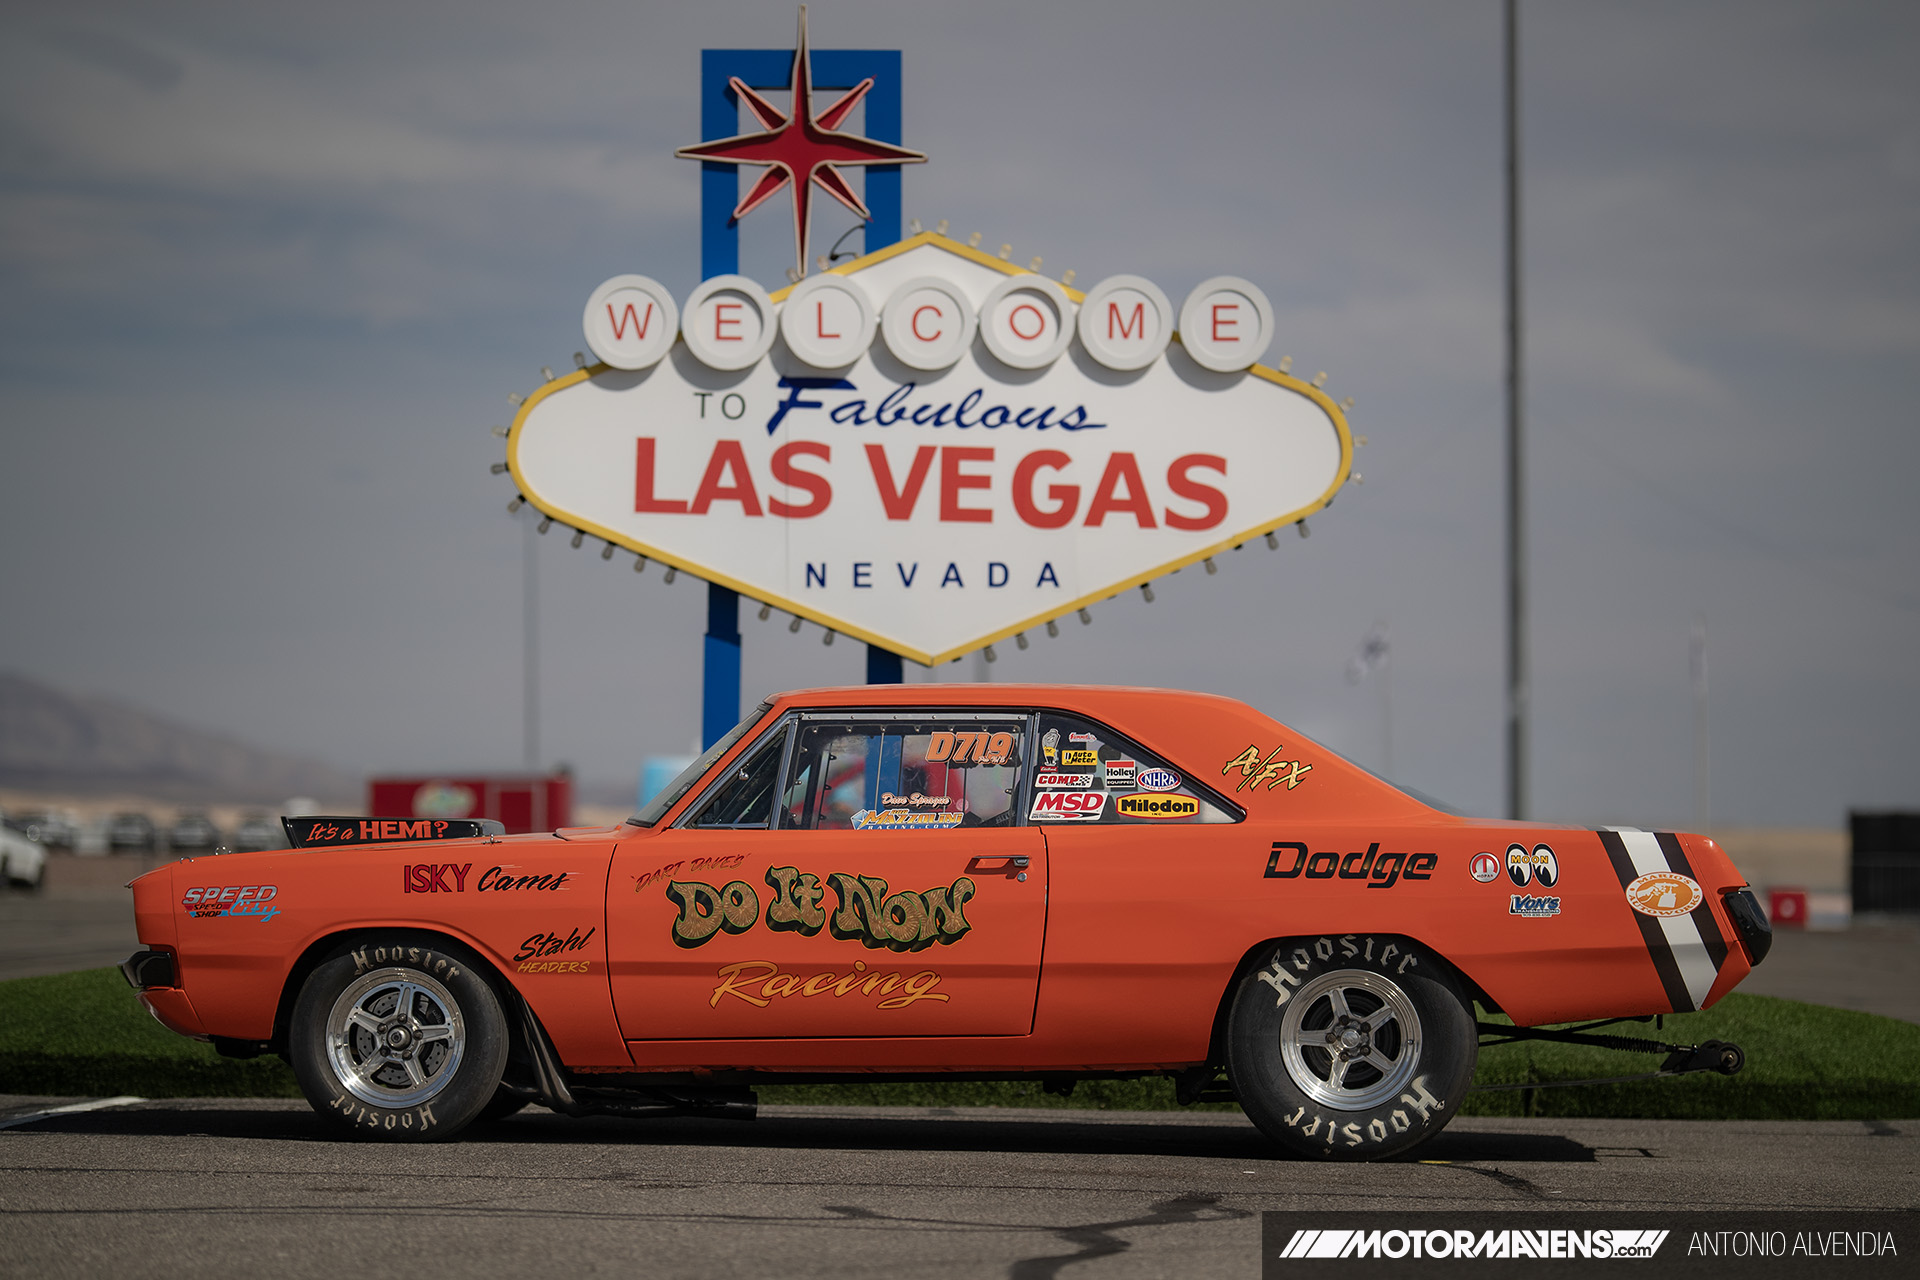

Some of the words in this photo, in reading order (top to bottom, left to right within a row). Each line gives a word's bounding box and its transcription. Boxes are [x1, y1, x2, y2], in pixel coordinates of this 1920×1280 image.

[606, 302, 1239, 343] WELCOME
[693, 392, 746, 420] TO
[766, 376, 1107, 435] Fabulous
[633, 437, 832, 518] LAS
[864, 444, 1229, 531] VEGAS
[805, 562, 1060, 589] NEVADA
[925, 732, 1015, 763] D719
[1038, 775, 1080, 784] COMP
[1106, 768, 1135, 778] Holley
[1144, 772, 1175, 786] NHRA
[1221, 744, 1313, 792] A/FX
[1036, 793, 1104, 811] MSD
[1121, 799, 1195, 812] Milodon
[305, 822, 339, 842] It's
[340, 827, 355, 840] a
[1263, 841, 1438, 889] Dodge
[1510, 855, 1549, 864] MOON
[404, 863, 472, 893] ISKY
[477, 866, 571, 892] Cams
[1636, 874, 1692, 885] MARIO'S
[182, 885, 278, 904] SPEED
[1628, 894, 1700, 916] AUTOWORKS
[194, 910, 222, 918] SHOP
[229, 899, 281, 922] City
[513, 927, 596, 962] Stahl
[351, 944, 460, 982] Hoosier
[517, 961, 591, 974] HEADERS
[1257, 934, 1419, 1008] Hoosier
[709, 960, 950, 1009] Racing
[329, 1094, 440, 1132] Hoosier
[1284, 1073, 1446, 1148] Hoosier
